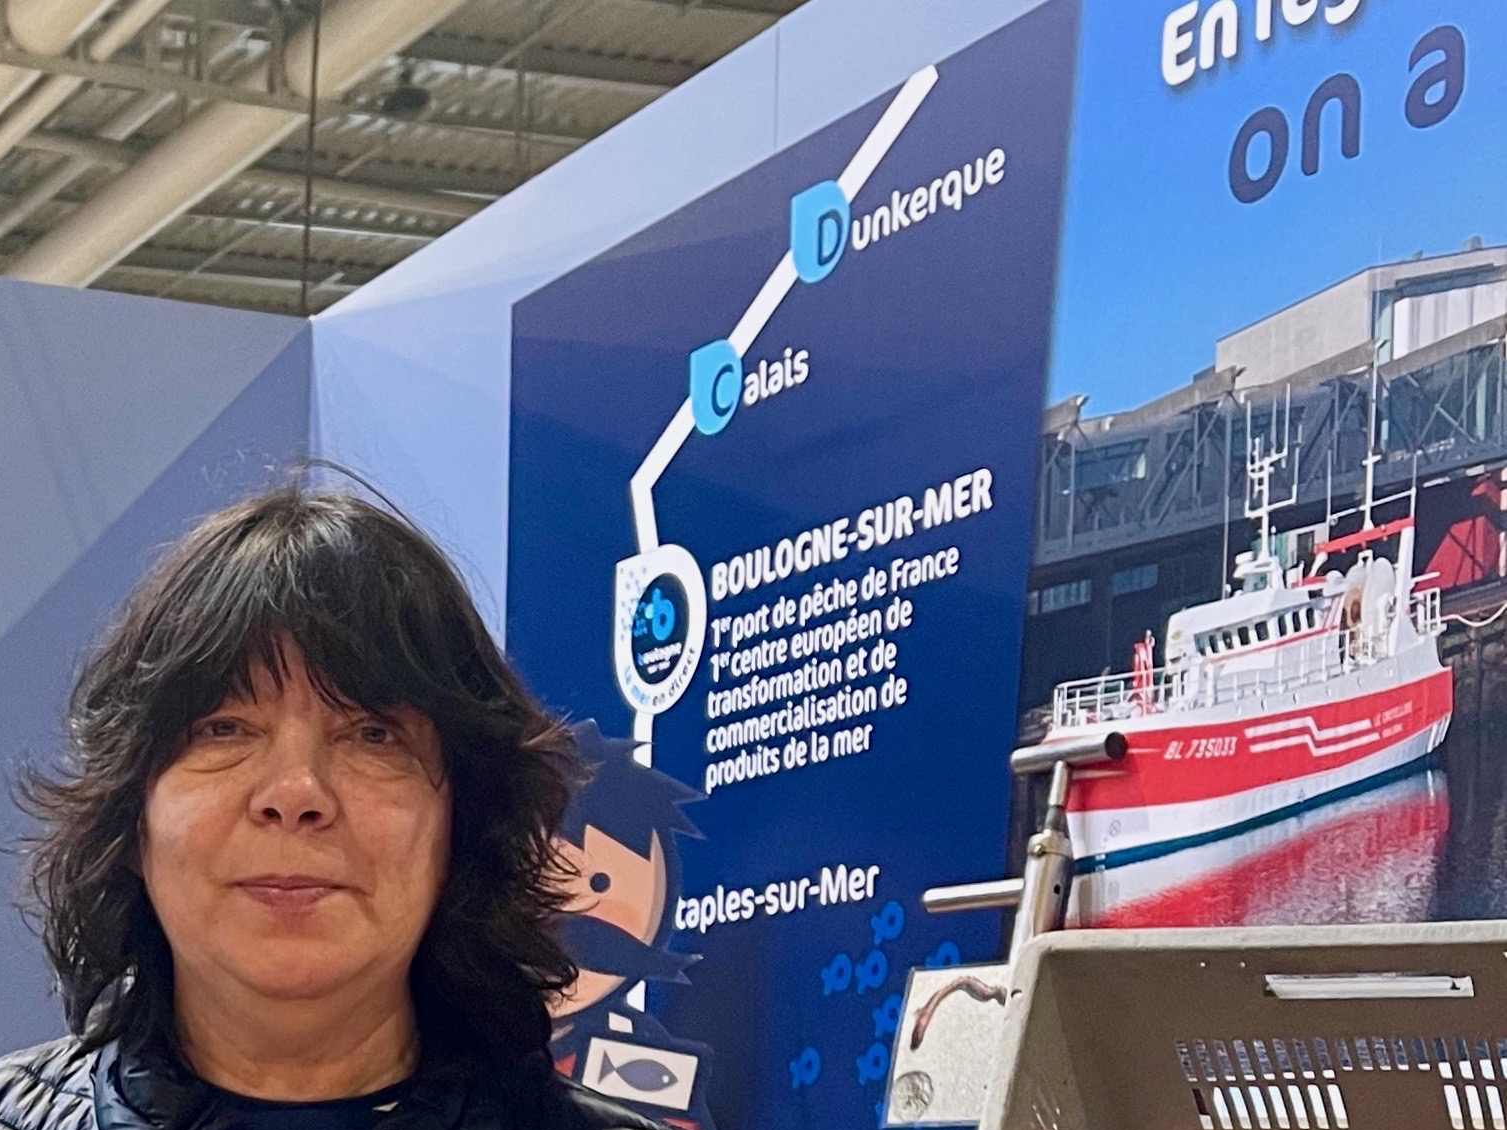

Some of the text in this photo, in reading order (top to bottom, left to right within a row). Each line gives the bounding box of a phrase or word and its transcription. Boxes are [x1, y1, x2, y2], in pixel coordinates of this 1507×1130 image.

[1161, 0, 1238, 86] En
[1228, 25, 1466, 204] on a
[818, 148, 1006, 267] Dunkerque
[711, 347, 809, 417] Calais
[711, 467, 993, 601] BOULOGNE-SUR-MER
[731, 636, 788, 678] centre
[791, 609, 882, 654] européen
[886, 596, 913, 630] de
[732, 604, 769, 648] port
[773, 595, 796, 629] de
[799, 577, 857, 626] pêche
[861, 566, 887, 601] de
[891, 547, 960, 592] France
[706, 674, 907, 753] commercialisation de
[707, 658, 842, 719] transformation
[846, 650, 866, 678] et
[870, 639, 896, 670] de
[705, 724, 872, 795] produits de la mer
[675, 863, 880, 934] taples-sur-Mer
